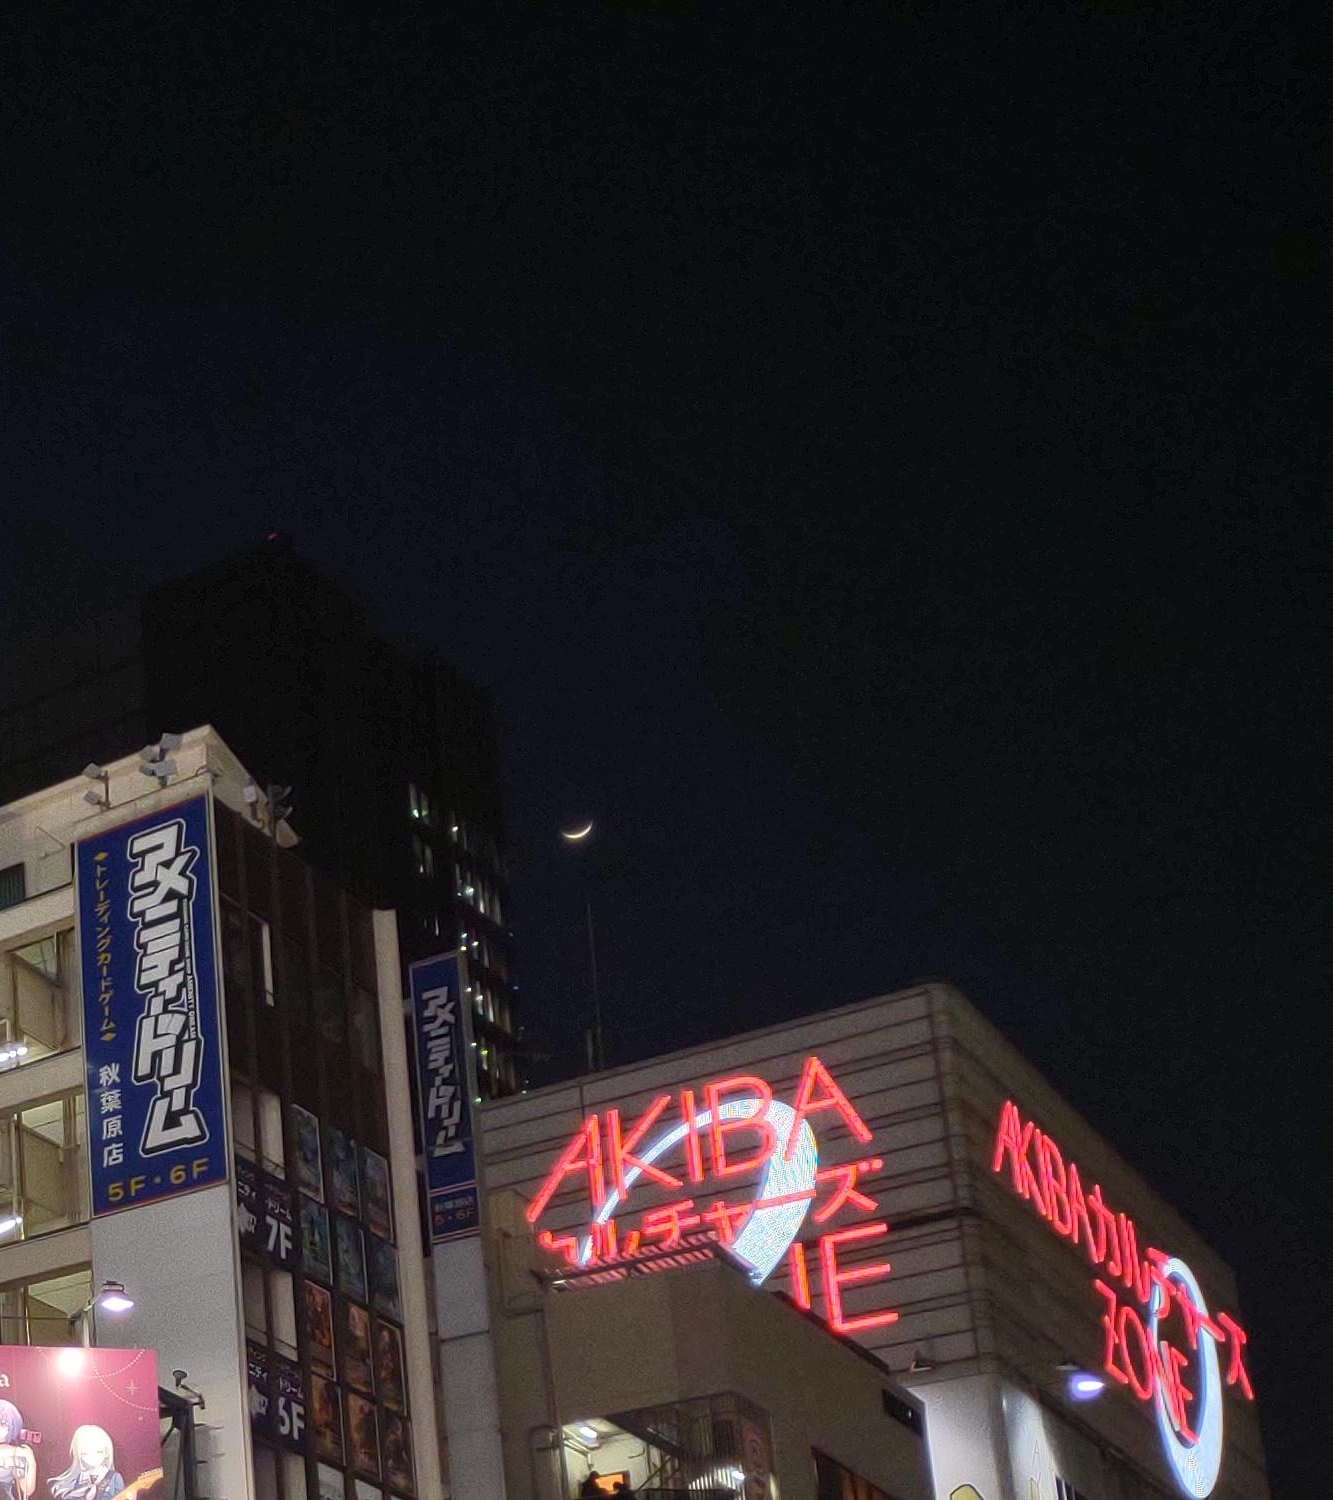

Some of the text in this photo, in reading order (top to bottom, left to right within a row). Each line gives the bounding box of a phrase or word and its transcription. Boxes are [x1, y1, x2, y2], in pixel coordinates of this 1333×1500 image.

[94, 863, 115, 1031] トレーディングカードゲーム
[127, 818, 209, 1158] アメニティドリーム
[98, 1063, 125, 1168] 秋葉原店
[527, 1054, 874, 1224] AKIBA
[265, 1215, 293, 1259] 7F
